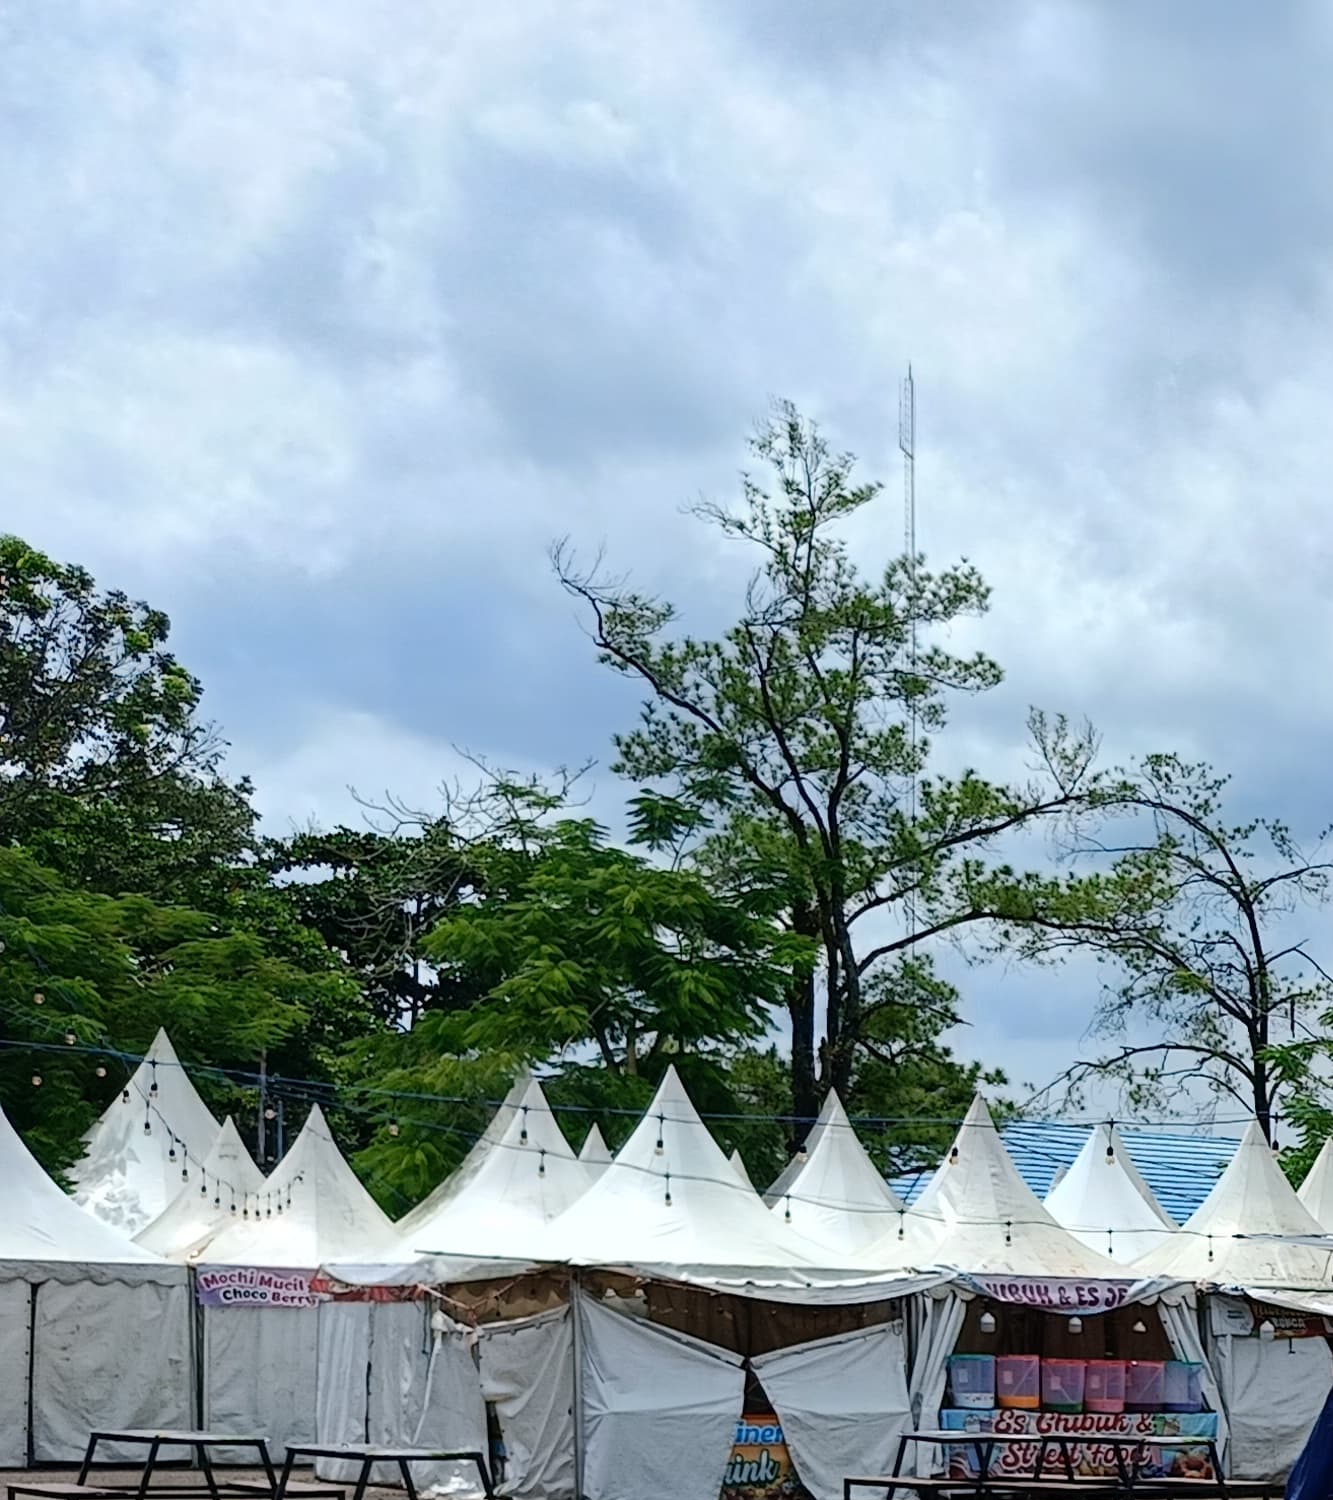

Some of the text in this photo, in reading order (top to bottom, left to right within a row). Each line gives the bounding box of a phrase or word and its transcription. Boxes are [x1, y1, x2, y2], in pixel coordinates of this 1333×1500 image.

[202, 1271, 255, 1289] Mochi
[222, 1288, 317, 1306] Choco Berry
[1058, 1286, 1072, 1304] &
[1075, 1285, 1099, 1307] ES
[994, 1410, 1026, 1434] Es
[1136, 1413, 1155, 1433] &
